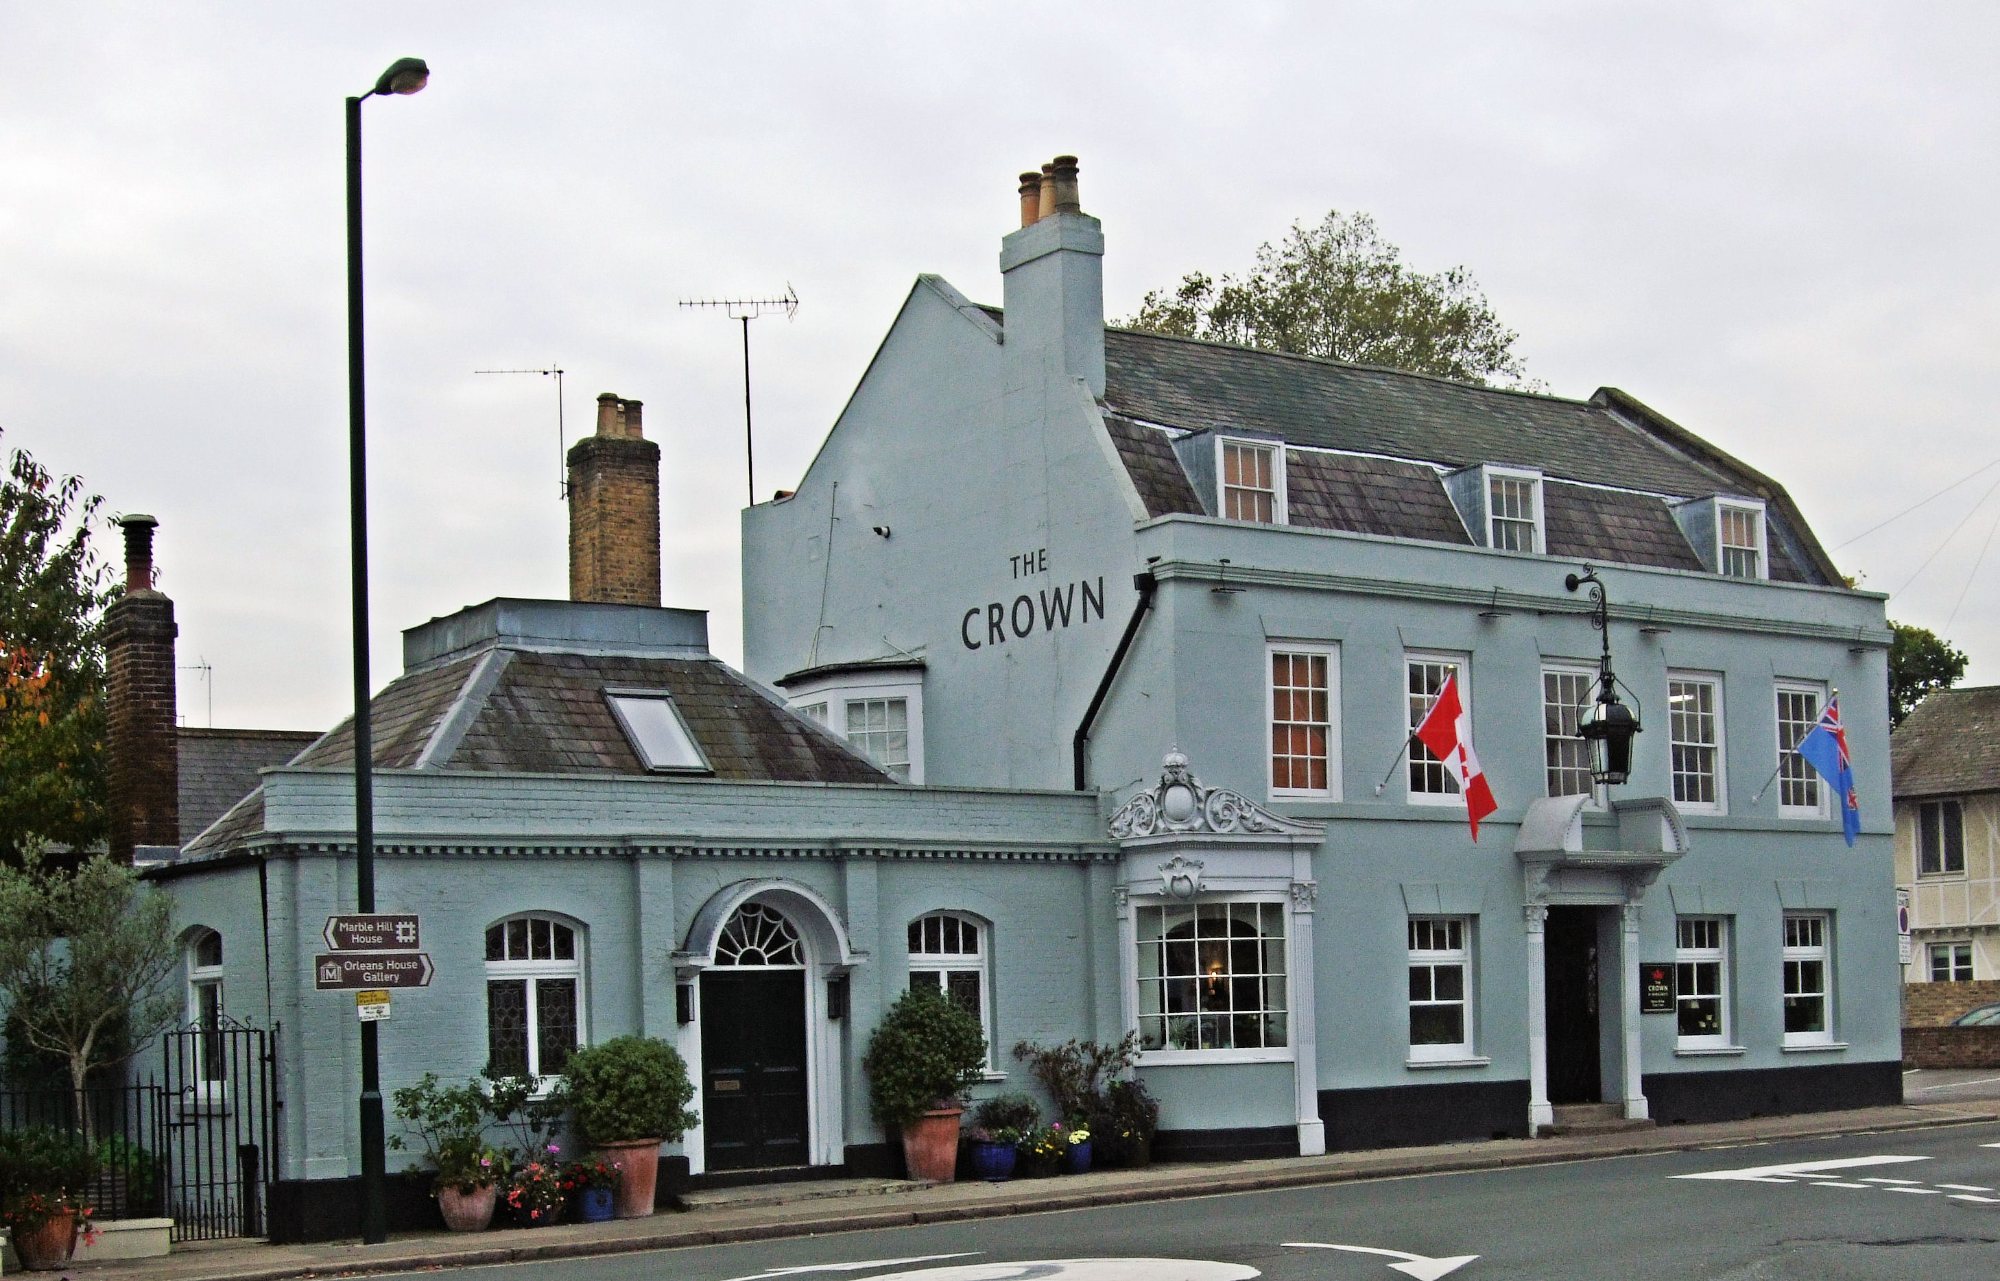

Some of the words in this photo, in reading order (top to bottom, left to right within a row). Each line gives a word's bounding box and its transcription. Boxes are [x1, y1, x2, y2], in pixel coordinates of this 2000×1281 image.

[1009, 548, 1047, 579] THE
[961, 576, 1105, 651] CROWN
[339, 923, 373, 932] Marble
[377, 921, 393, 931] Hill
[352, 934, 382, 943] House
[344, 961, 384, 970] Orleans
[387, 960, 418, 970] House
[363, 972, 400, 983] Gallery
